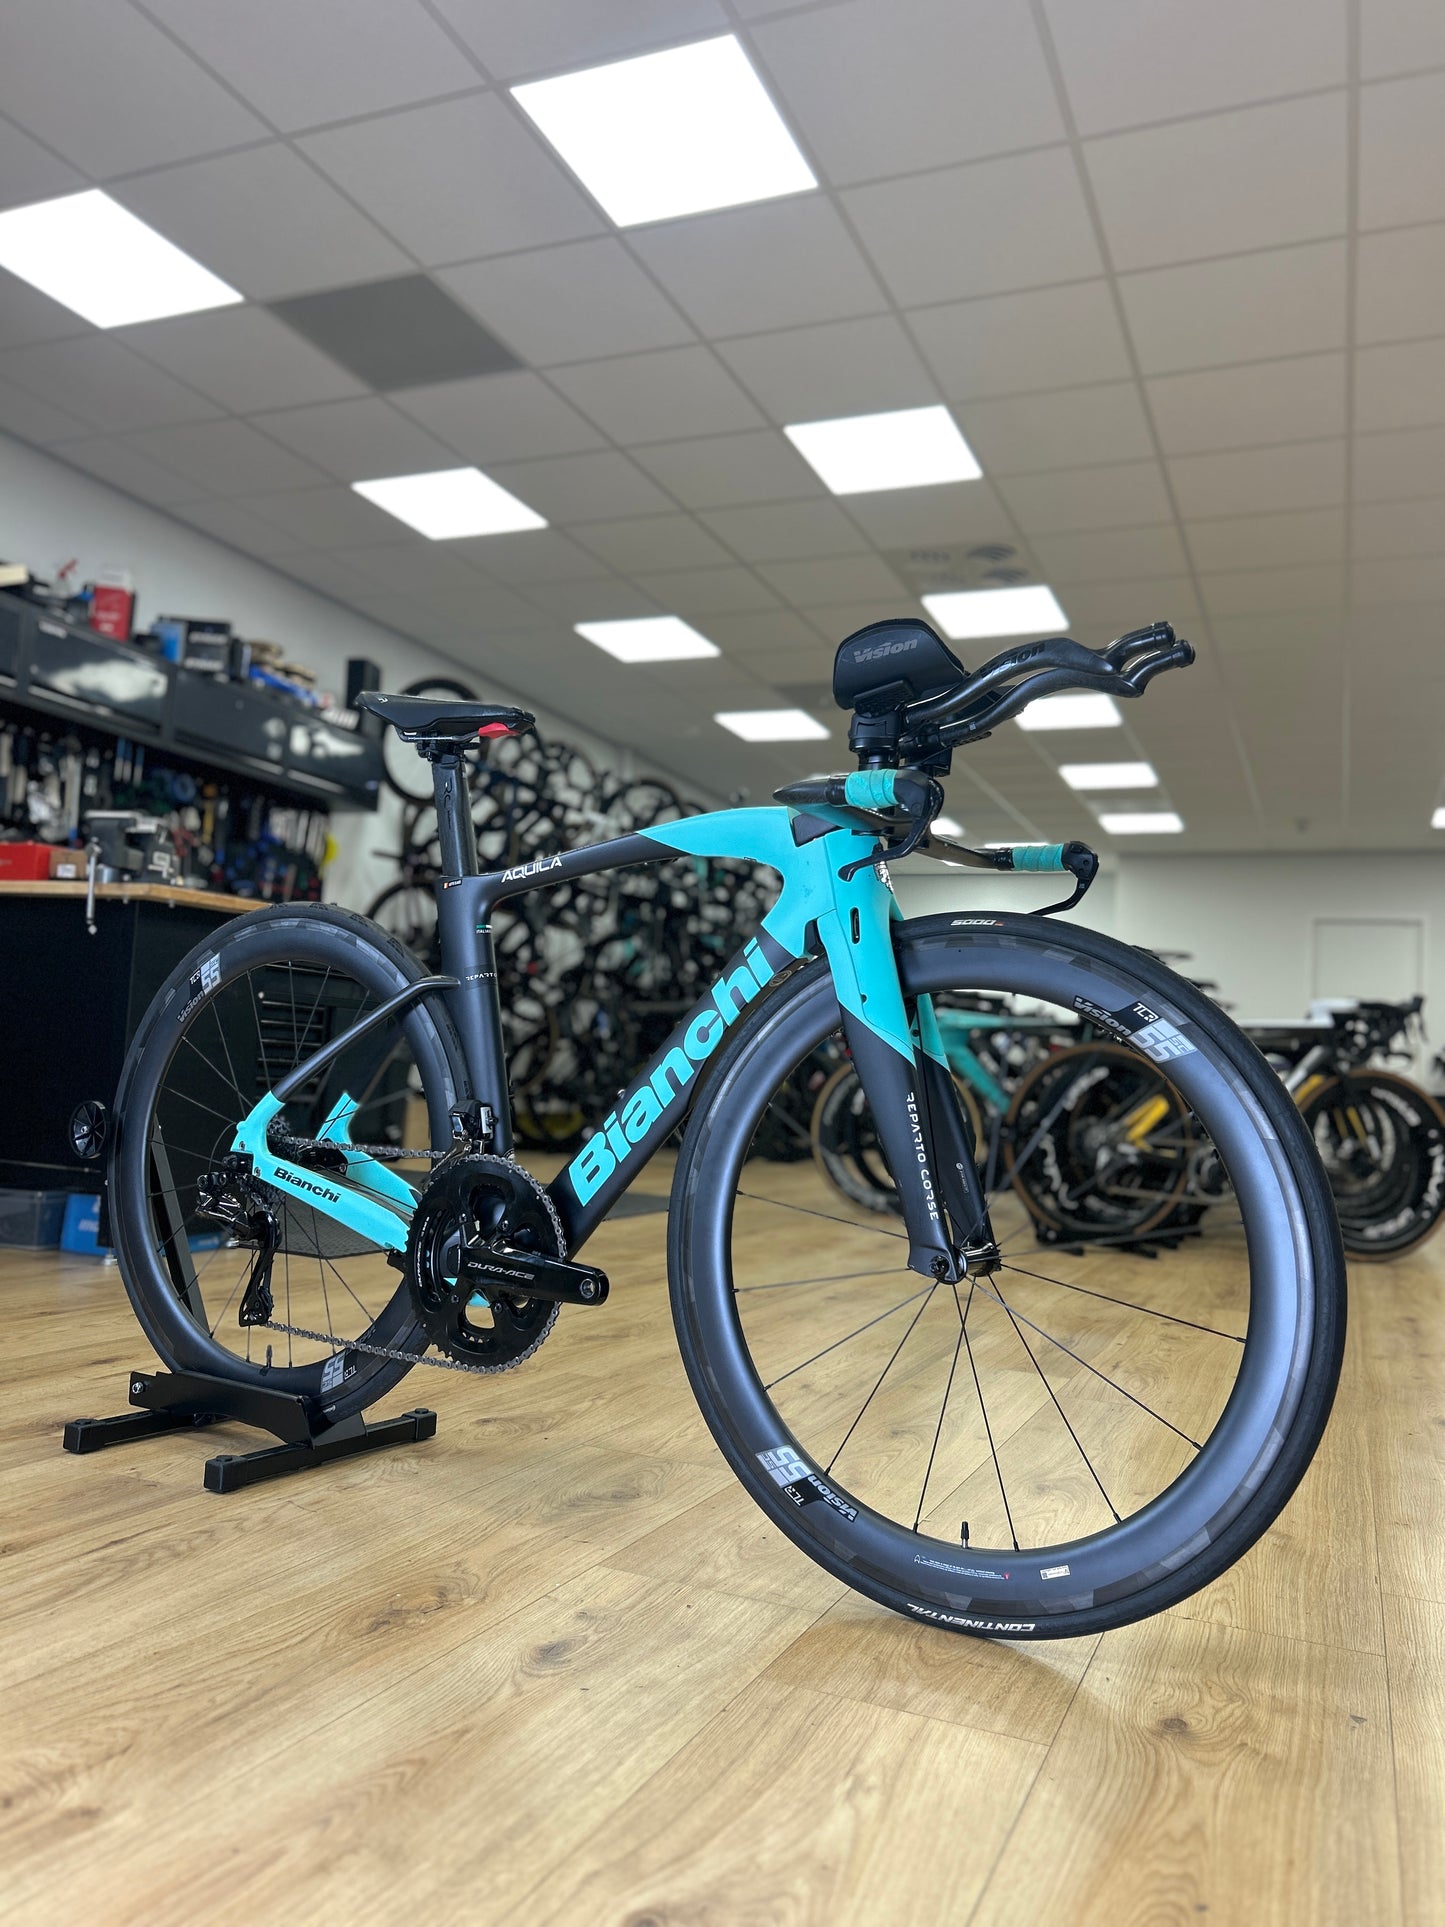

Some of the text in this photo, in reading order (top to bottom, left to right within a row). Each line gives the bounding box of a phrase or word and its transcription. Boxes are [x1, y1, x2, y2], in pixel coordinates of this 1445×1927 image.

[853, 639, 918, 664] Vision
[501, 857, 562, 883] AQUILA
[1074, 997, 1132, 1036] Vision
[1132, 1002, 1159, 1023] TLR
[1131, 1025, 1182, 1062] 55
[568, 937, 774, 1207] Bianchi
[906, 1092, 939, 1220] REPARTO CORSE
[274, 1167, 341, 1203] Bianchi
[467, 1261, 536, 1281] DURA-ACE
[784, 1485, 805, 1506] TLR
[807, 1475, 858, 1521] Vision
[906, 1603, 1035, 1631] CONTINENTAL
